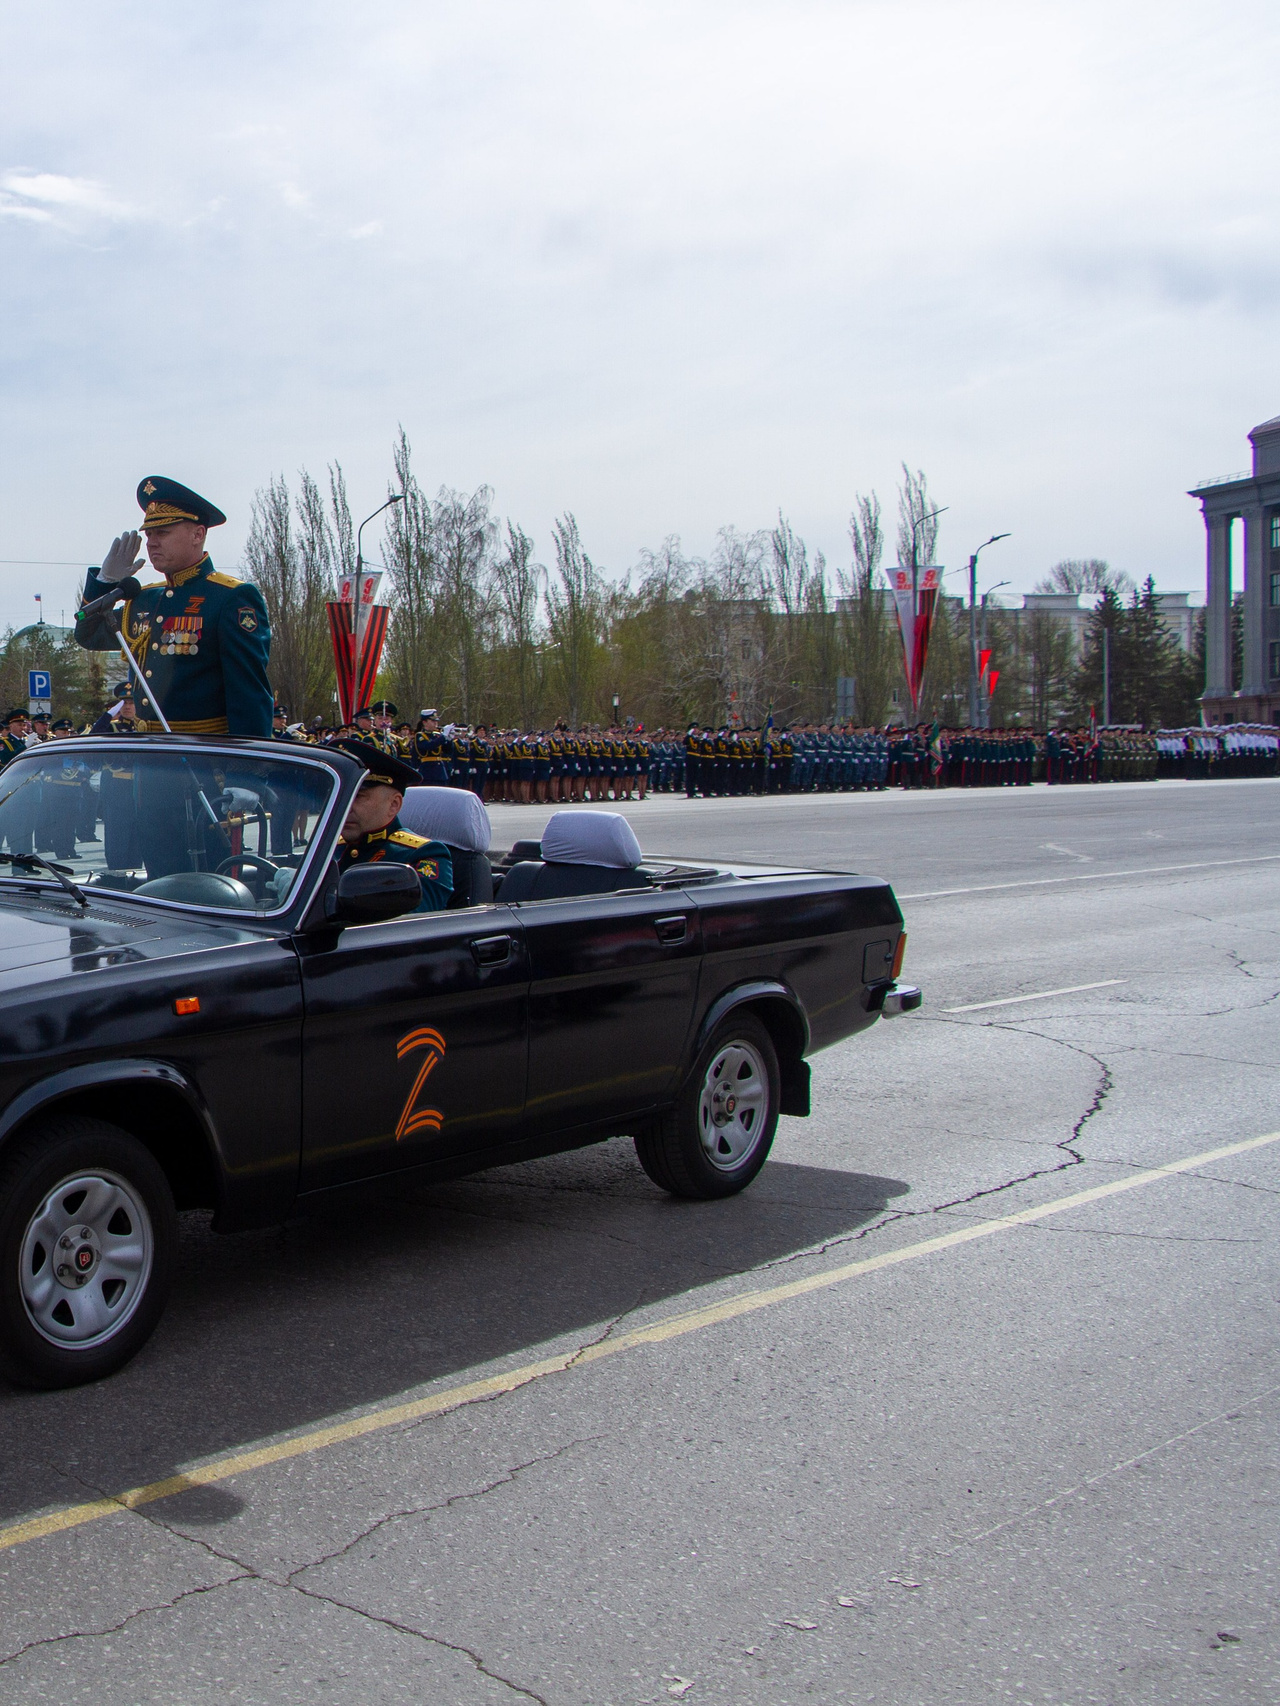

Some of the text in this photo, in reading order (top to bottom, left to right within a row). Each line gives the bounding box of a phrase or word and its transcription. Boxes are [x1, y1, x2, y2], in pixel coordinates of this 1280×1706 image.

[363, 577, 374, 595] 9
[897, 571, 906, 584] 9
[341, 581, 351, 598] 9
[35, 674, 47, 696] P
